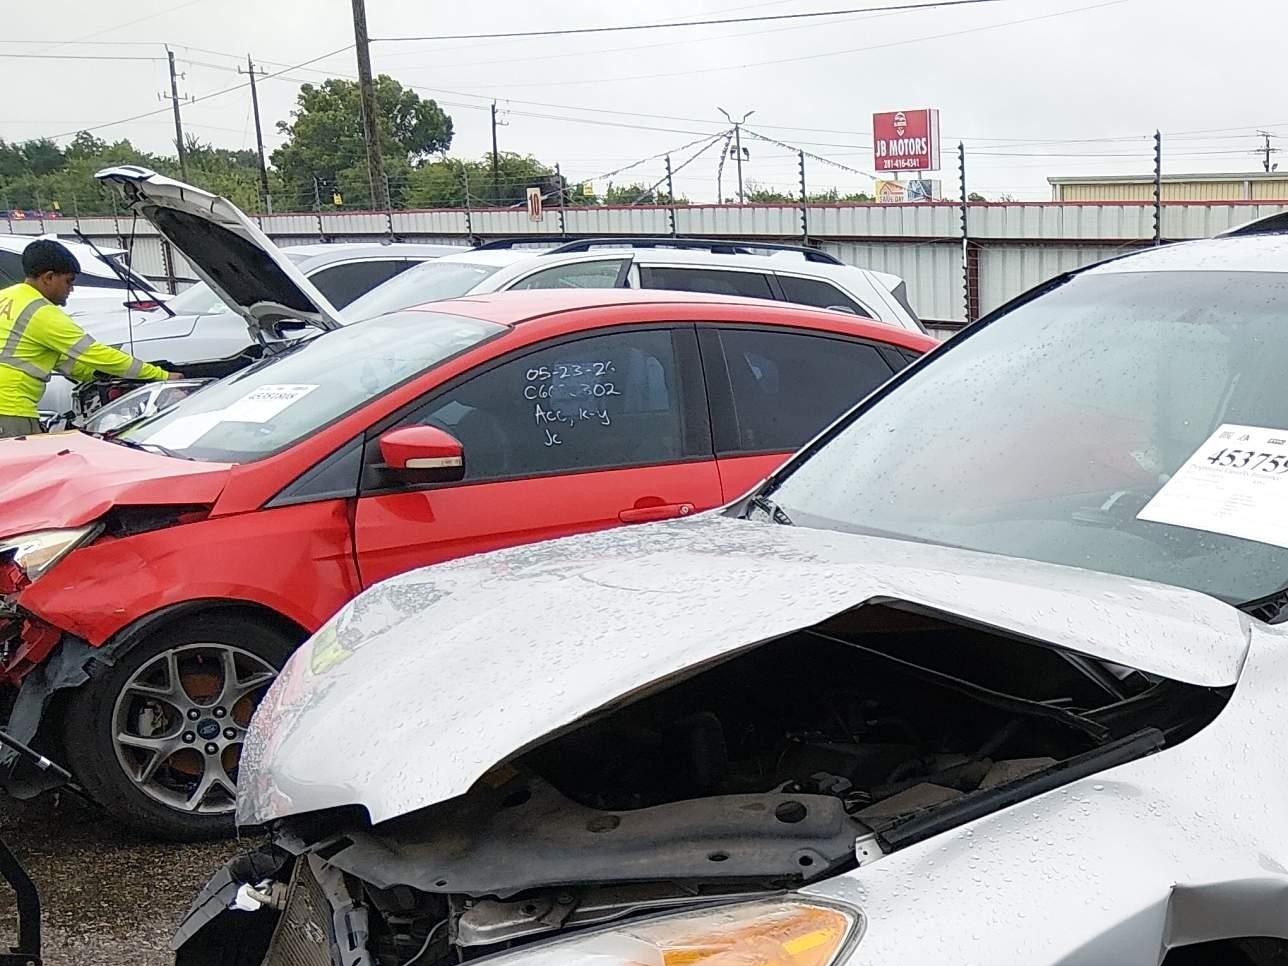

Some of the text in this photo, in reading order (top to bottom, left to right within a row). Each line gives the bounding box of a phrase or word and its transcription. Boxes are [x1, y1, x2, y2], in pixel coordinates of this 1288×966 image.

[875, 137, 928, 157] JB MOTORS
[529, 192, 540, 216] 10
